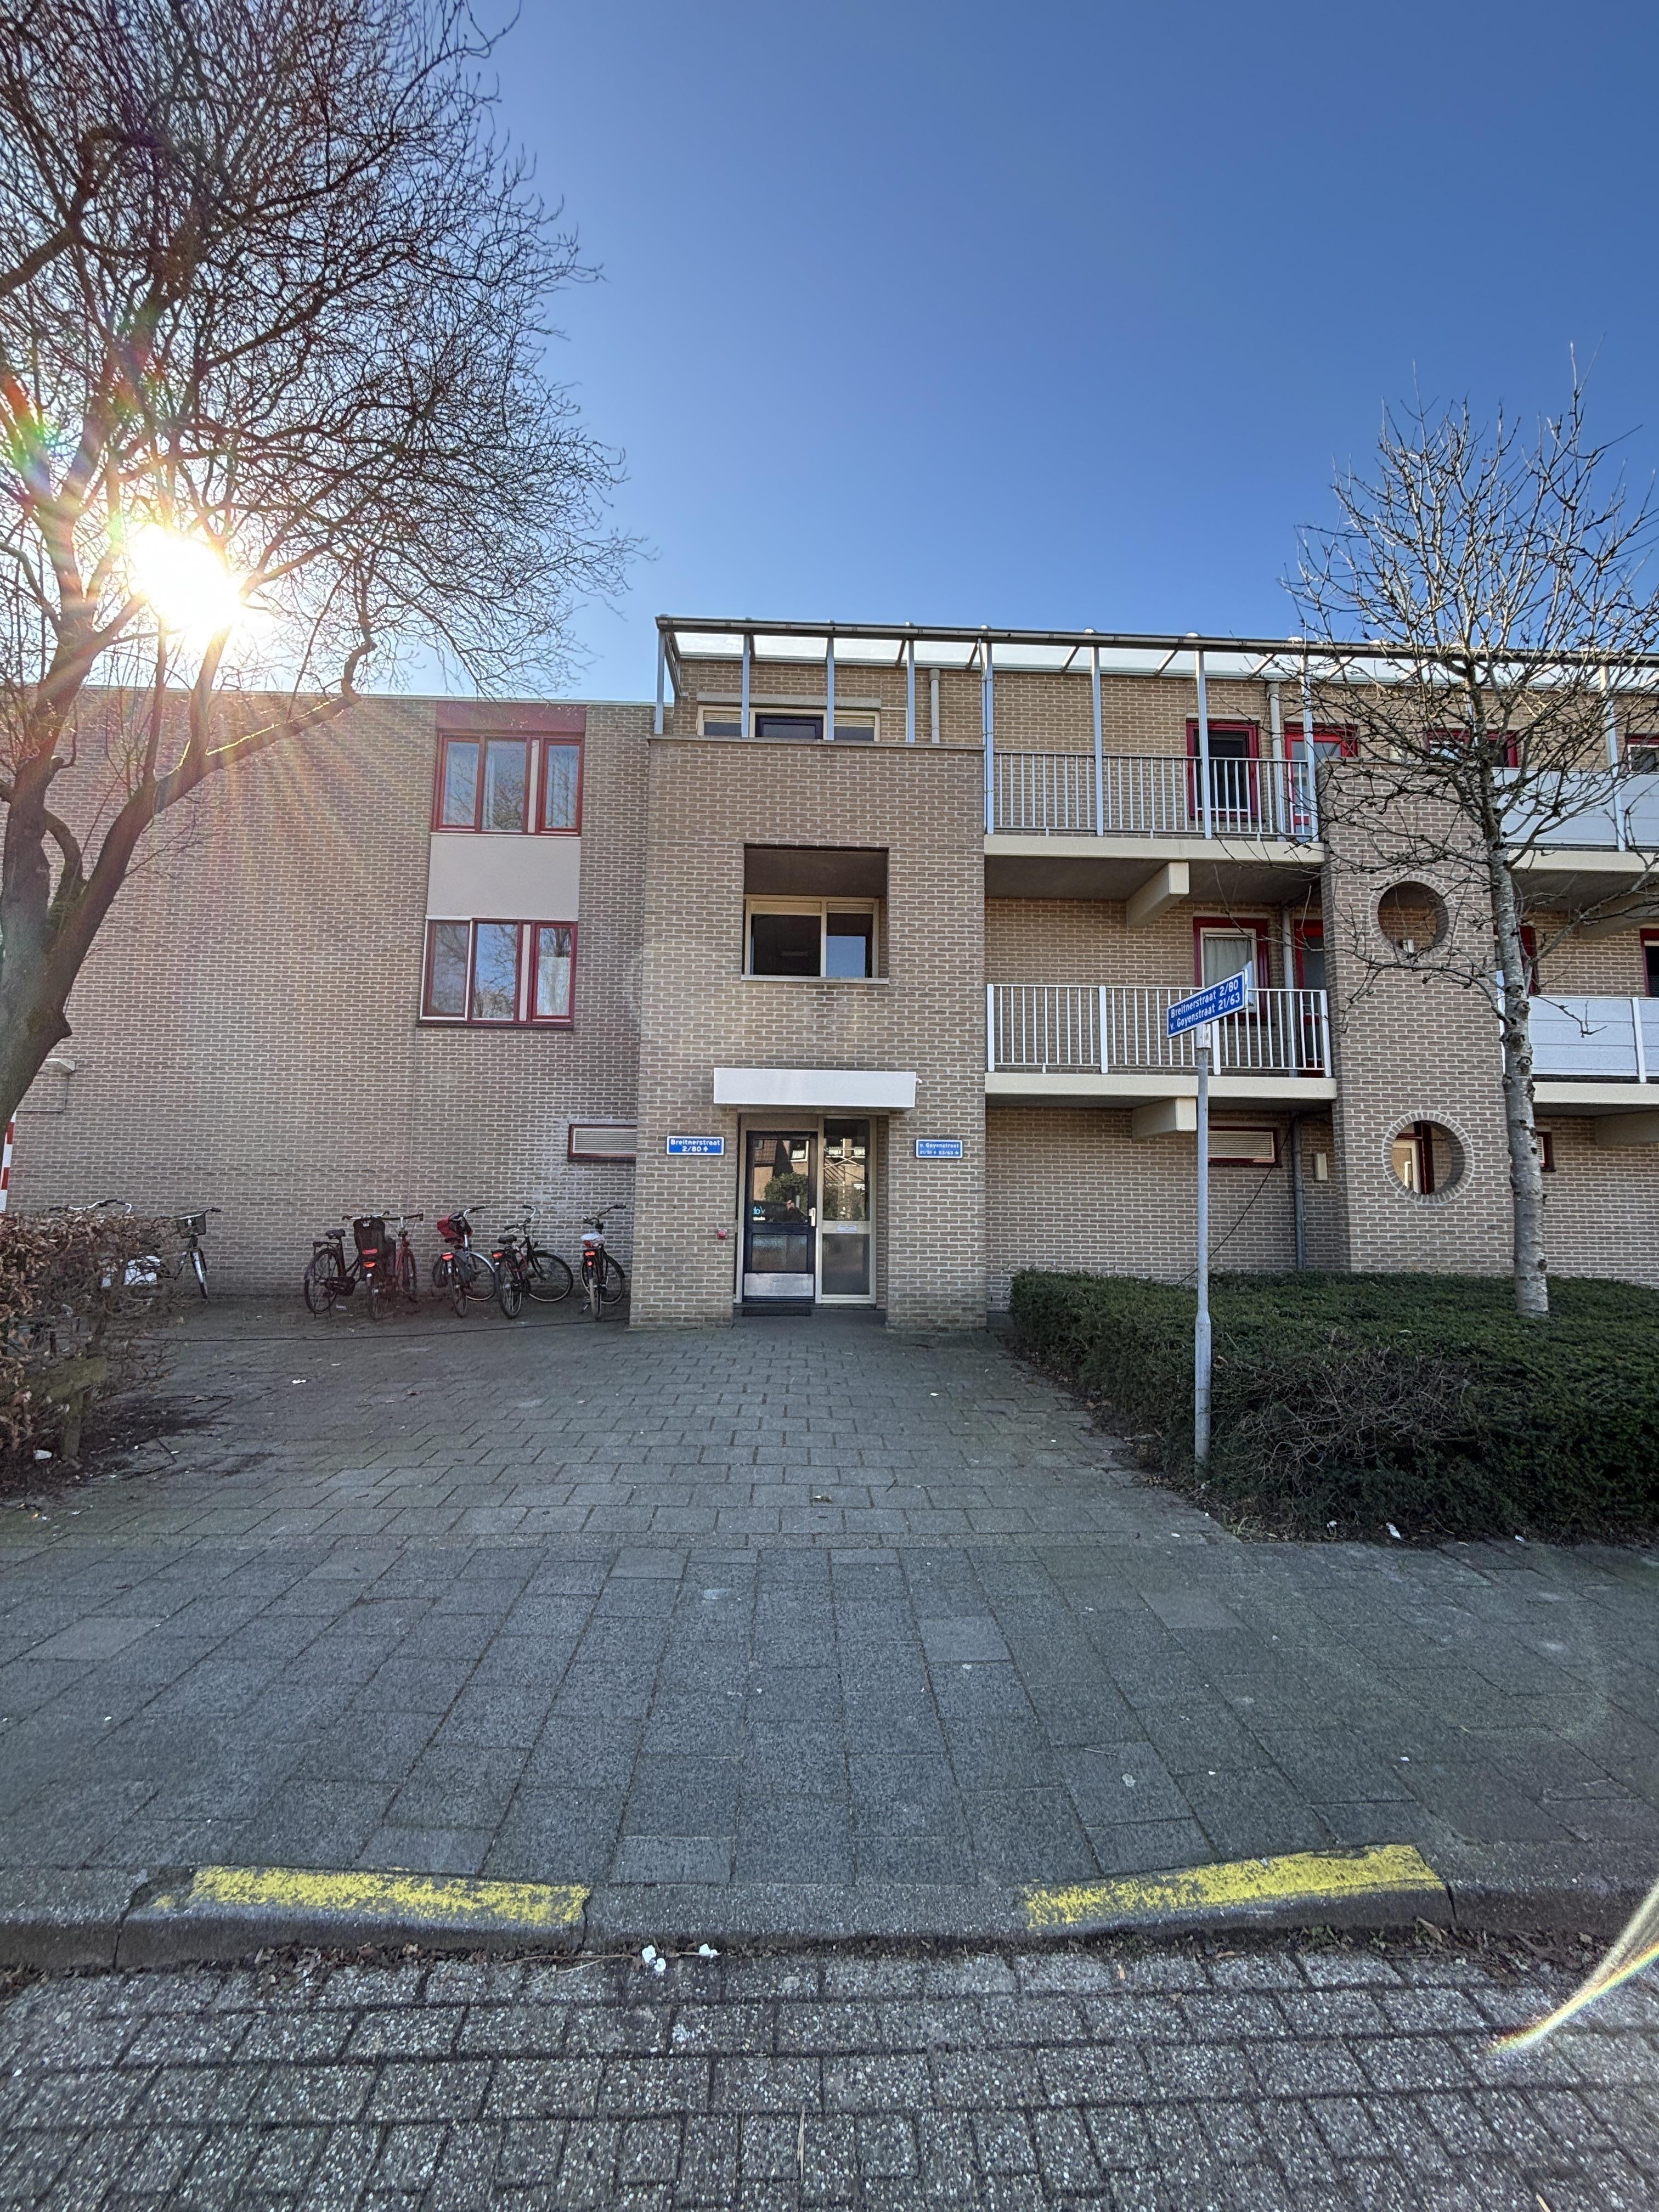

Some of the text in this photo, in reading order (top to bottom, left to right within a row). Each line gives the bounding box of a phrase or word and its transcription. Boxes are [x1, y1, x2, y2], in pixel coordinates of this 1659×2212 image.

[1171, 979, 1239, 1018] Breitnerstraat 2/80
[1177, 1003, 1215, 1028] Goyenstraat
[1218, 992, 1240, 1011] 21/63
